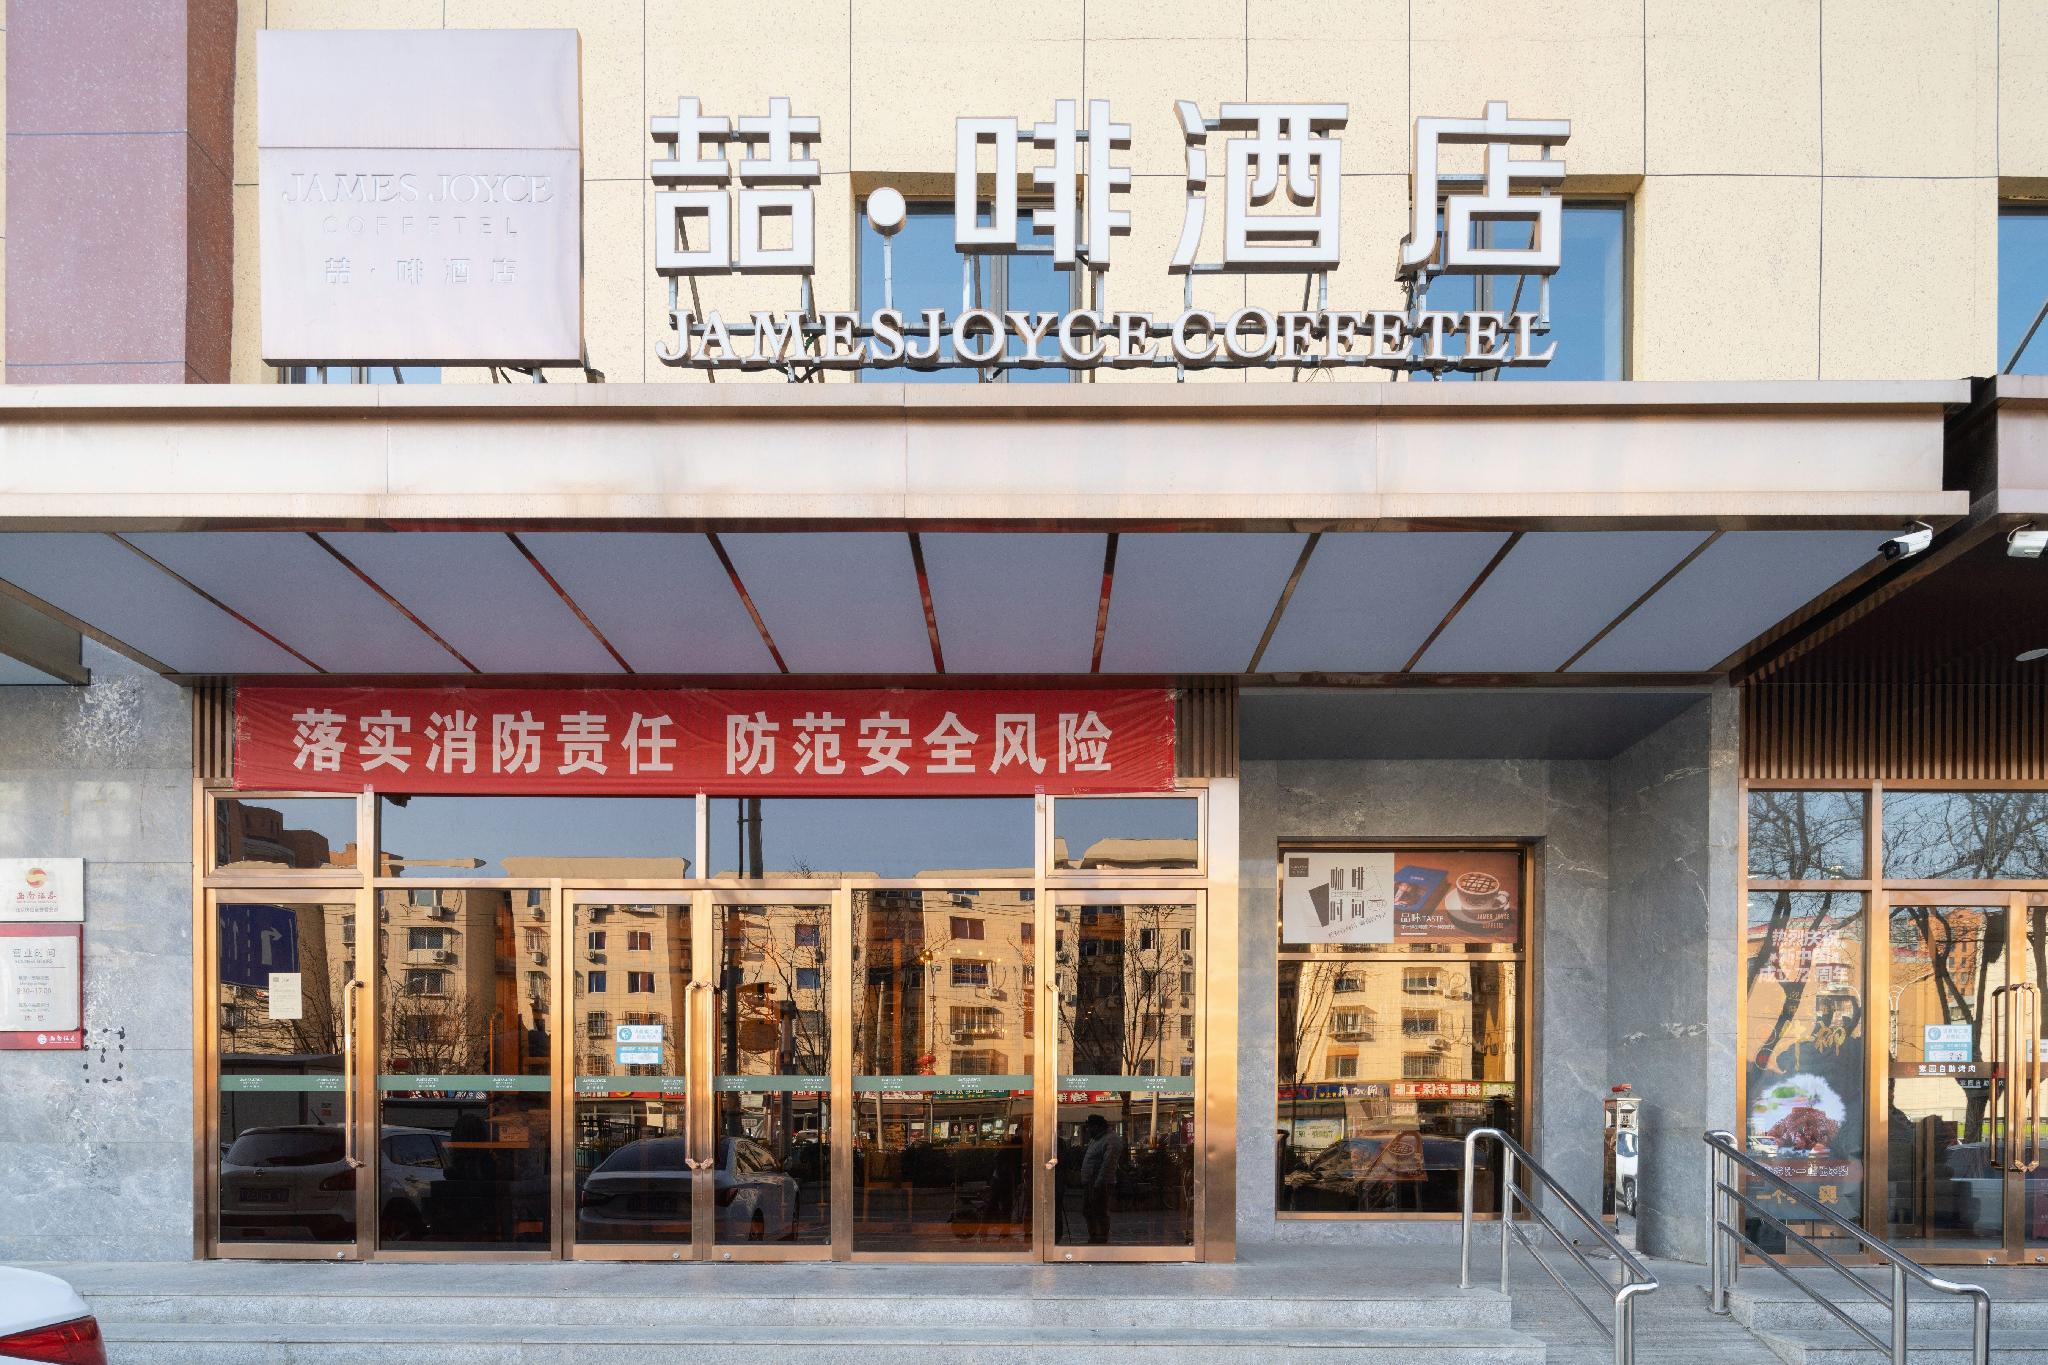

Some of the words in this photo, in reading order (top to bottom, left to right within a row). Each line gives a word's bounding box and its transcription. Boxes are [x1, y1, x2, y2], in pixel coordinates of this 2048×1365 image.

[282, 173, 418, 202] JAMES
[428, 173, 554, 203] JOYCE
[649, 96, 1572, 276] 喆·啡酒店
[322, 216, 518, 235] COFFETEL
[290, 708, 678, 776] 落实消防责任
[727, 710, 1116, 775] 防范安全风险
[1329, 867, 1365, 890] 咖啡
